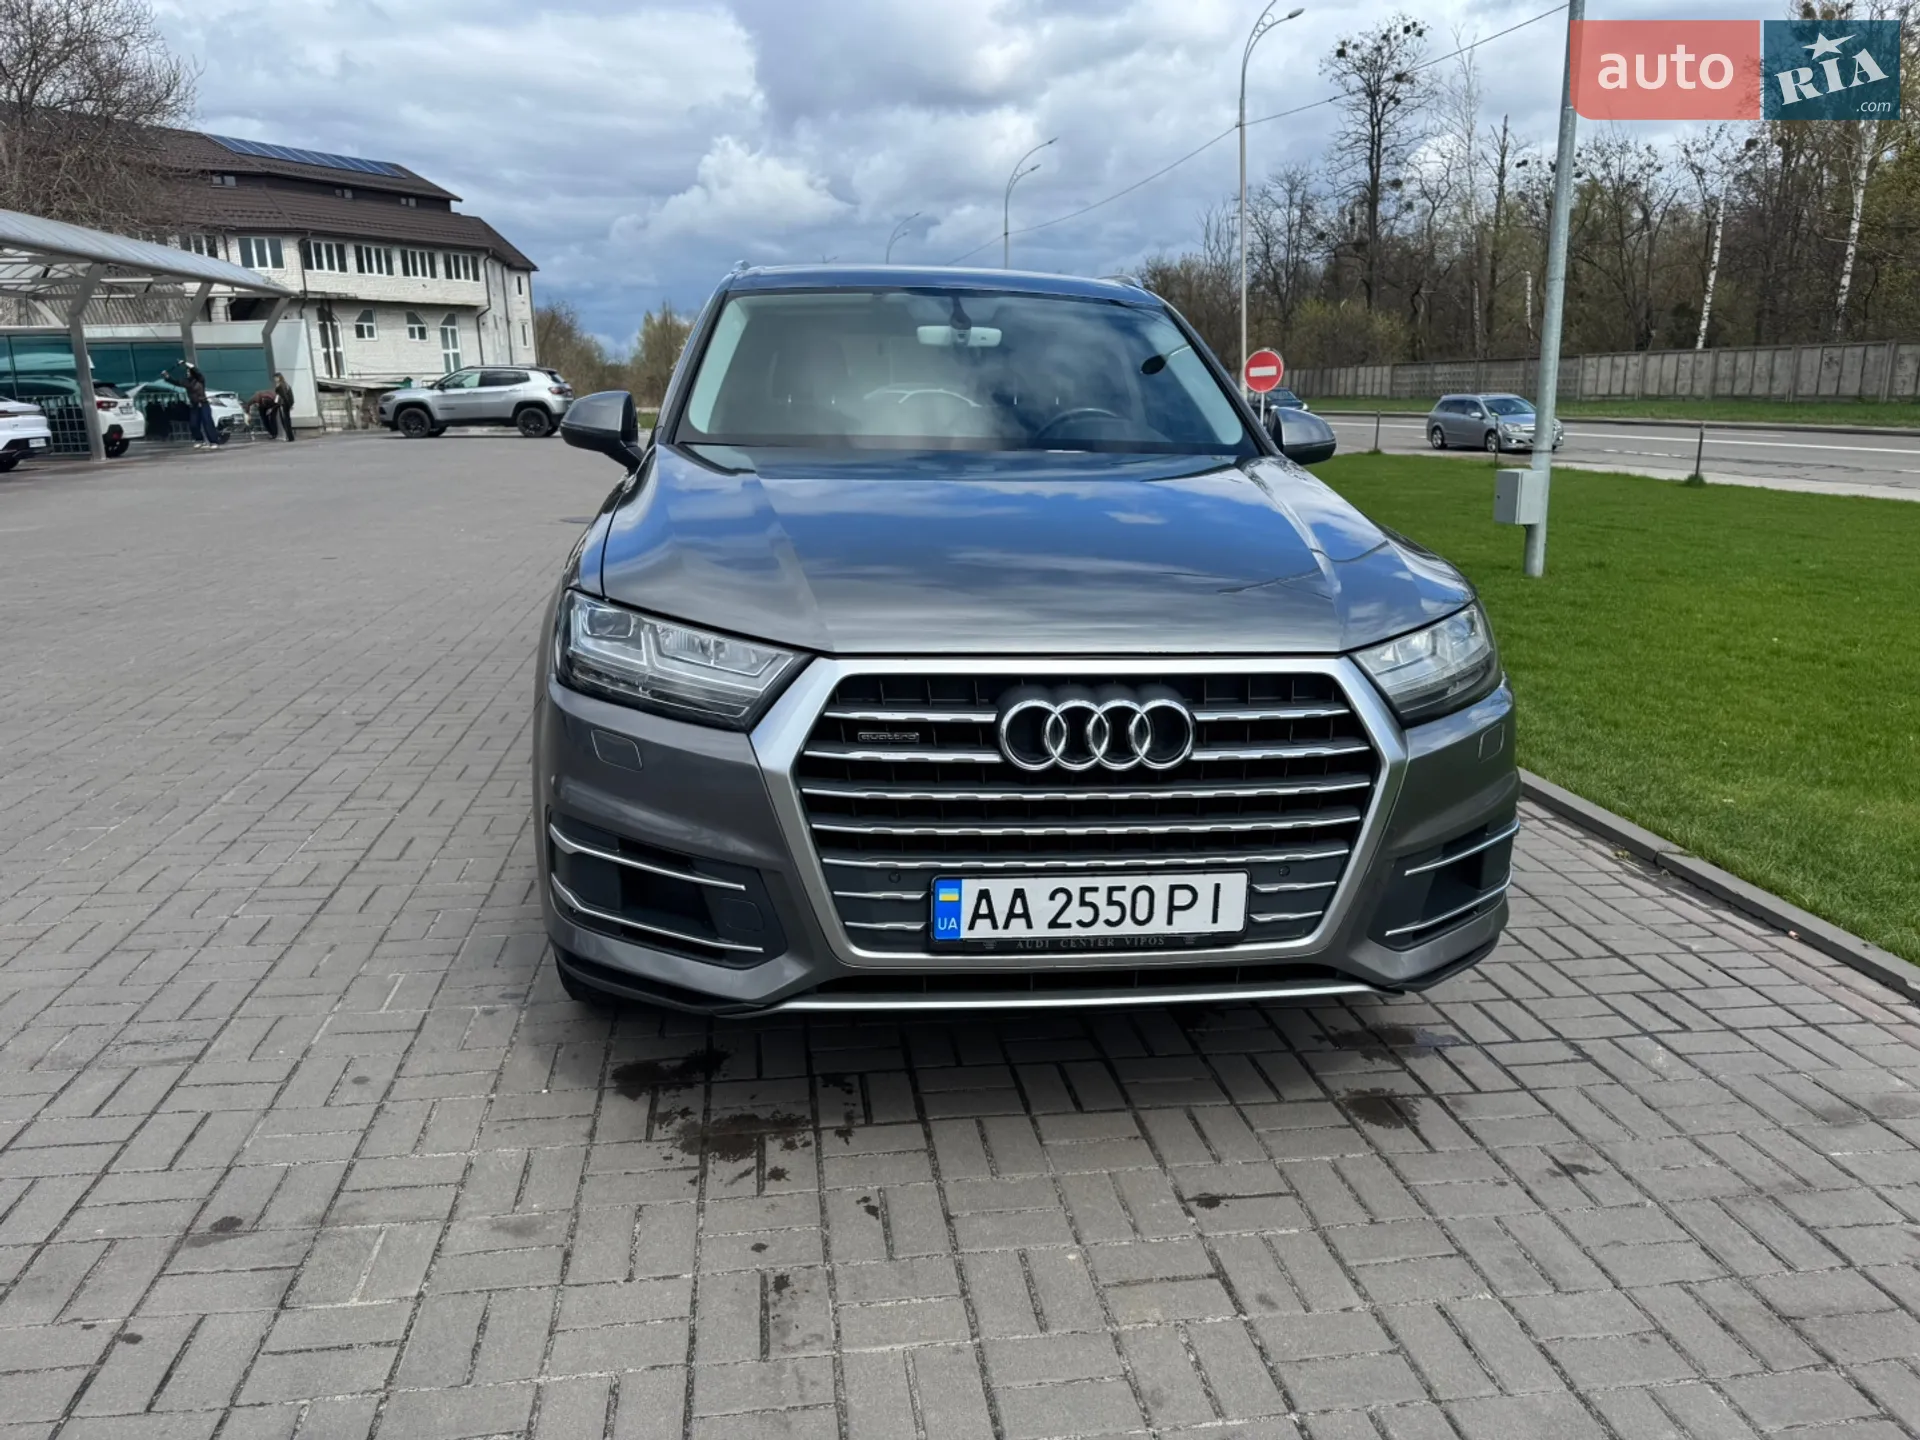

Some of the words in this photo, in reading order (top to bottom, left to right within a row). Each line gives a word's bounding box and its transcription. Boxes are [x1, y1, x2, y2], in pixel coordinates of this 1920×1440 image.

[968, 888, 1033, 931] AA
[1047, 885, 1155, 930] 2550
[1166, 883, 1221, 926] PI
[937, 917, 958, 930] UA
[1016, 939, 1050, 949] AUDI
[1060, 938, 1115, 948] CENTER
